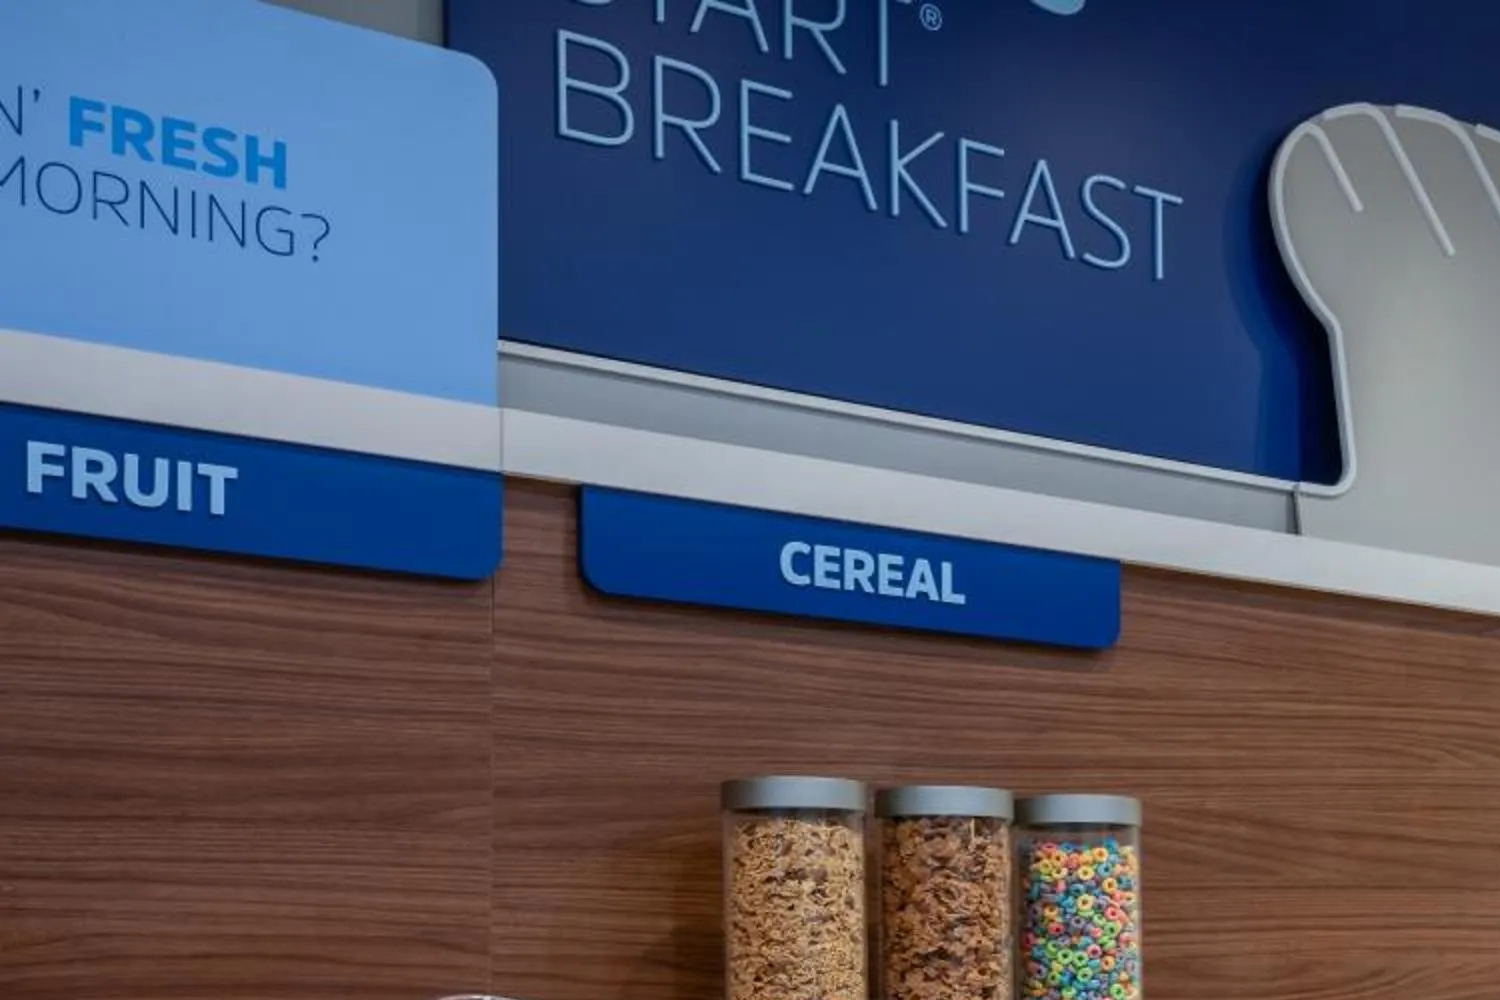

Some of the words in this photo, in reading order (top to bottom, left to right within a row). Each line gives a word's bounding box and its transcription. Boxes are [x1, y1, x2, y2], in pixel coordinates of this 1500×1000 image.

[68, 94, 288, 191] FRESH
[556, 28, 1184, 281] BREAKFAST
[26, 440, 239, 516] FRUIT
[779, 541, 966, 605] CEREAL
